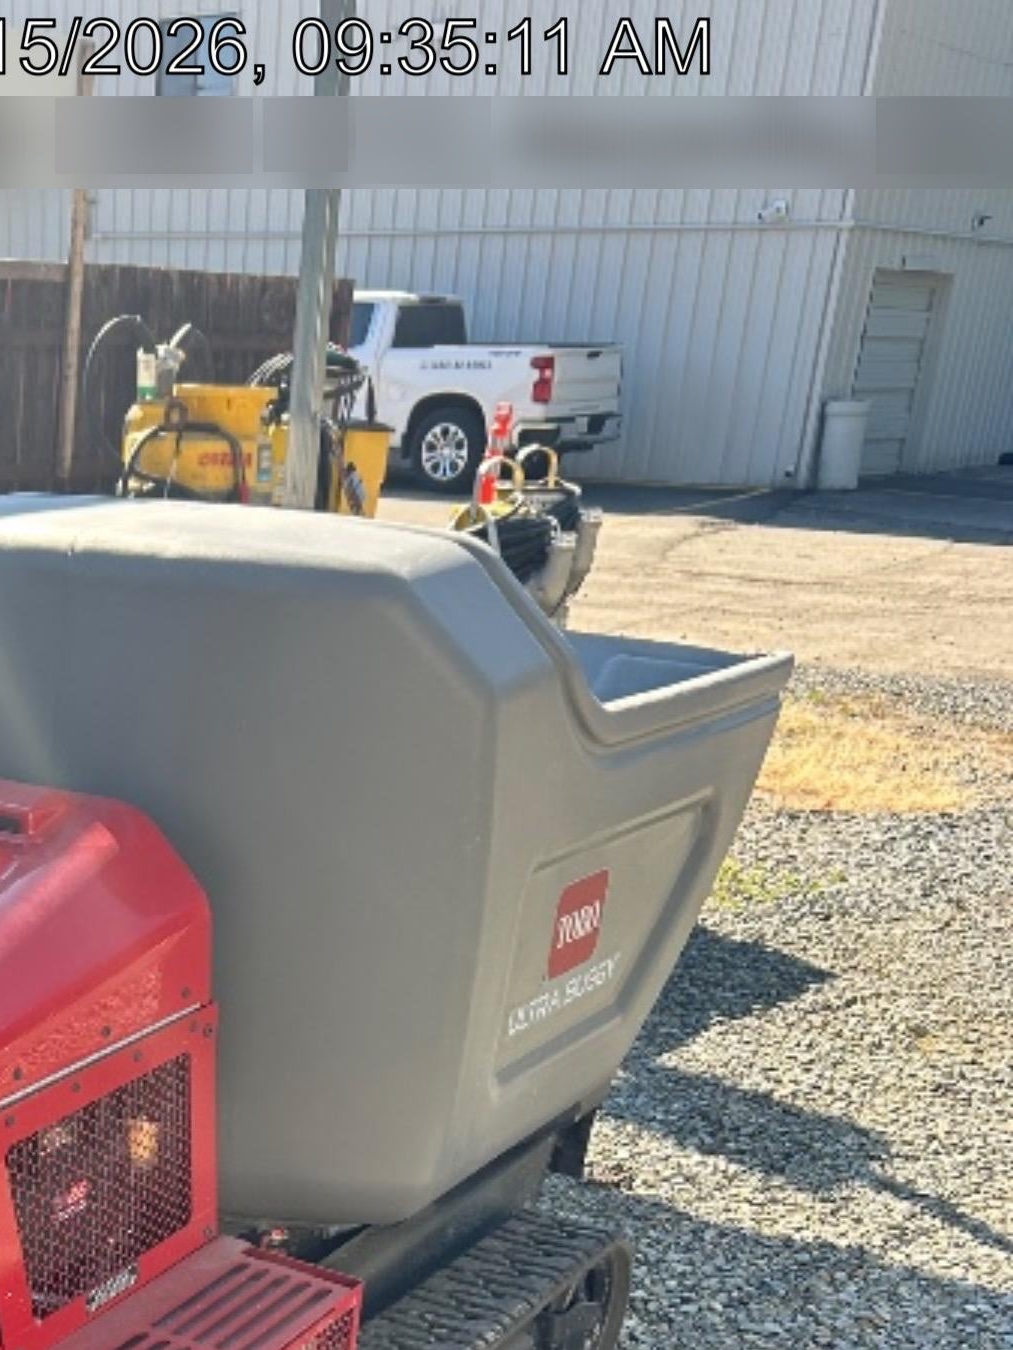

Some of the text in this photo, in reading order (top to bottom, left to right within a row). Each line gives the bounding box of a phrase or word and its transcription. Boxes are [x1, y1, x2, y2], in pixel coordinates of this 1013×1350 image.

[555, 900, 600, 949] TORO
[508, 958, 615, 1037] ULTRA BUGGY
